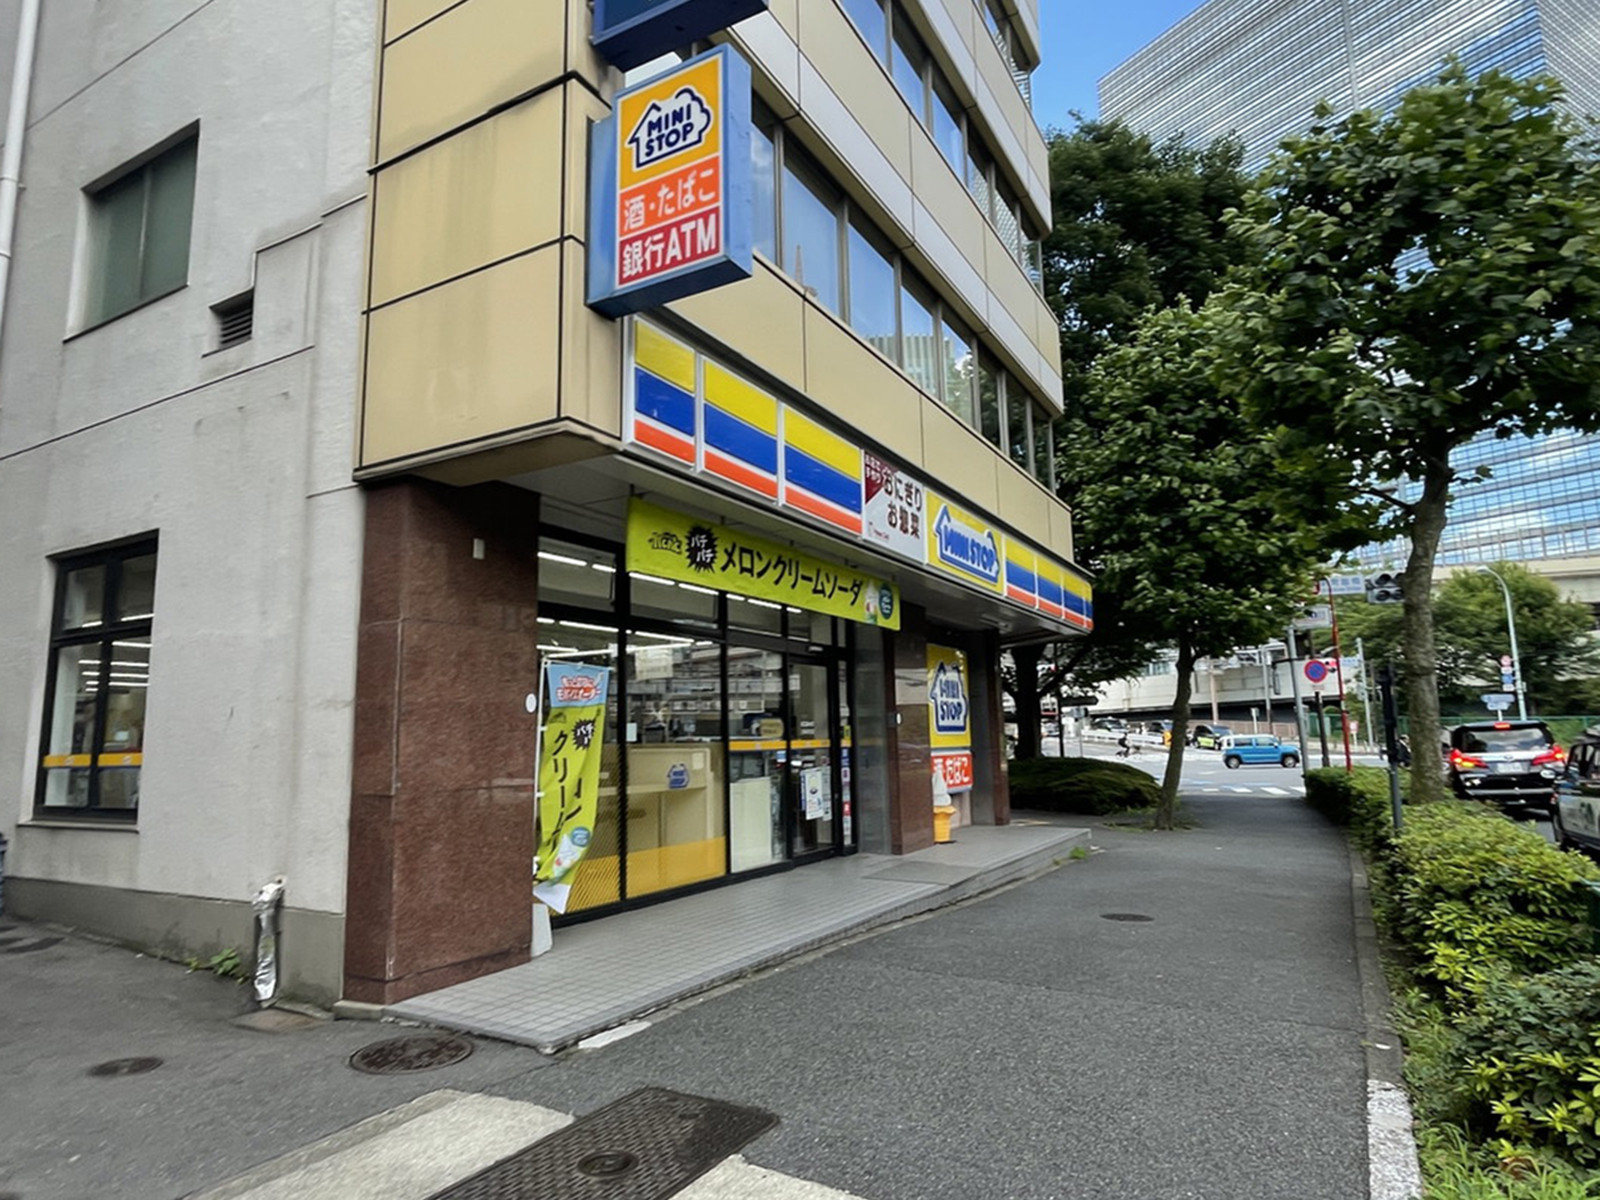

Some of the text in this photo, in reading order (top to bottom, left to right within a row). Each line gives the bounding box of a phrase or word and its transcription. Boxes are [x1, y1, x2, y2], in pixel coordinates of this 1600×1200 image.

[647, 103, 692, 137] MINI
[644, 125, 694, 157] STOP
[623, 168, 716, 231] 酒・たばこ
[622, 214, 716, 277] 銀行ATM
[883, 467, 923, 512] おにぎり
[720, 541, 863, 606] メロンクリームソーダ
[970, 538, 995, 573] STOP
[940, 700, 963, 721] STOP
